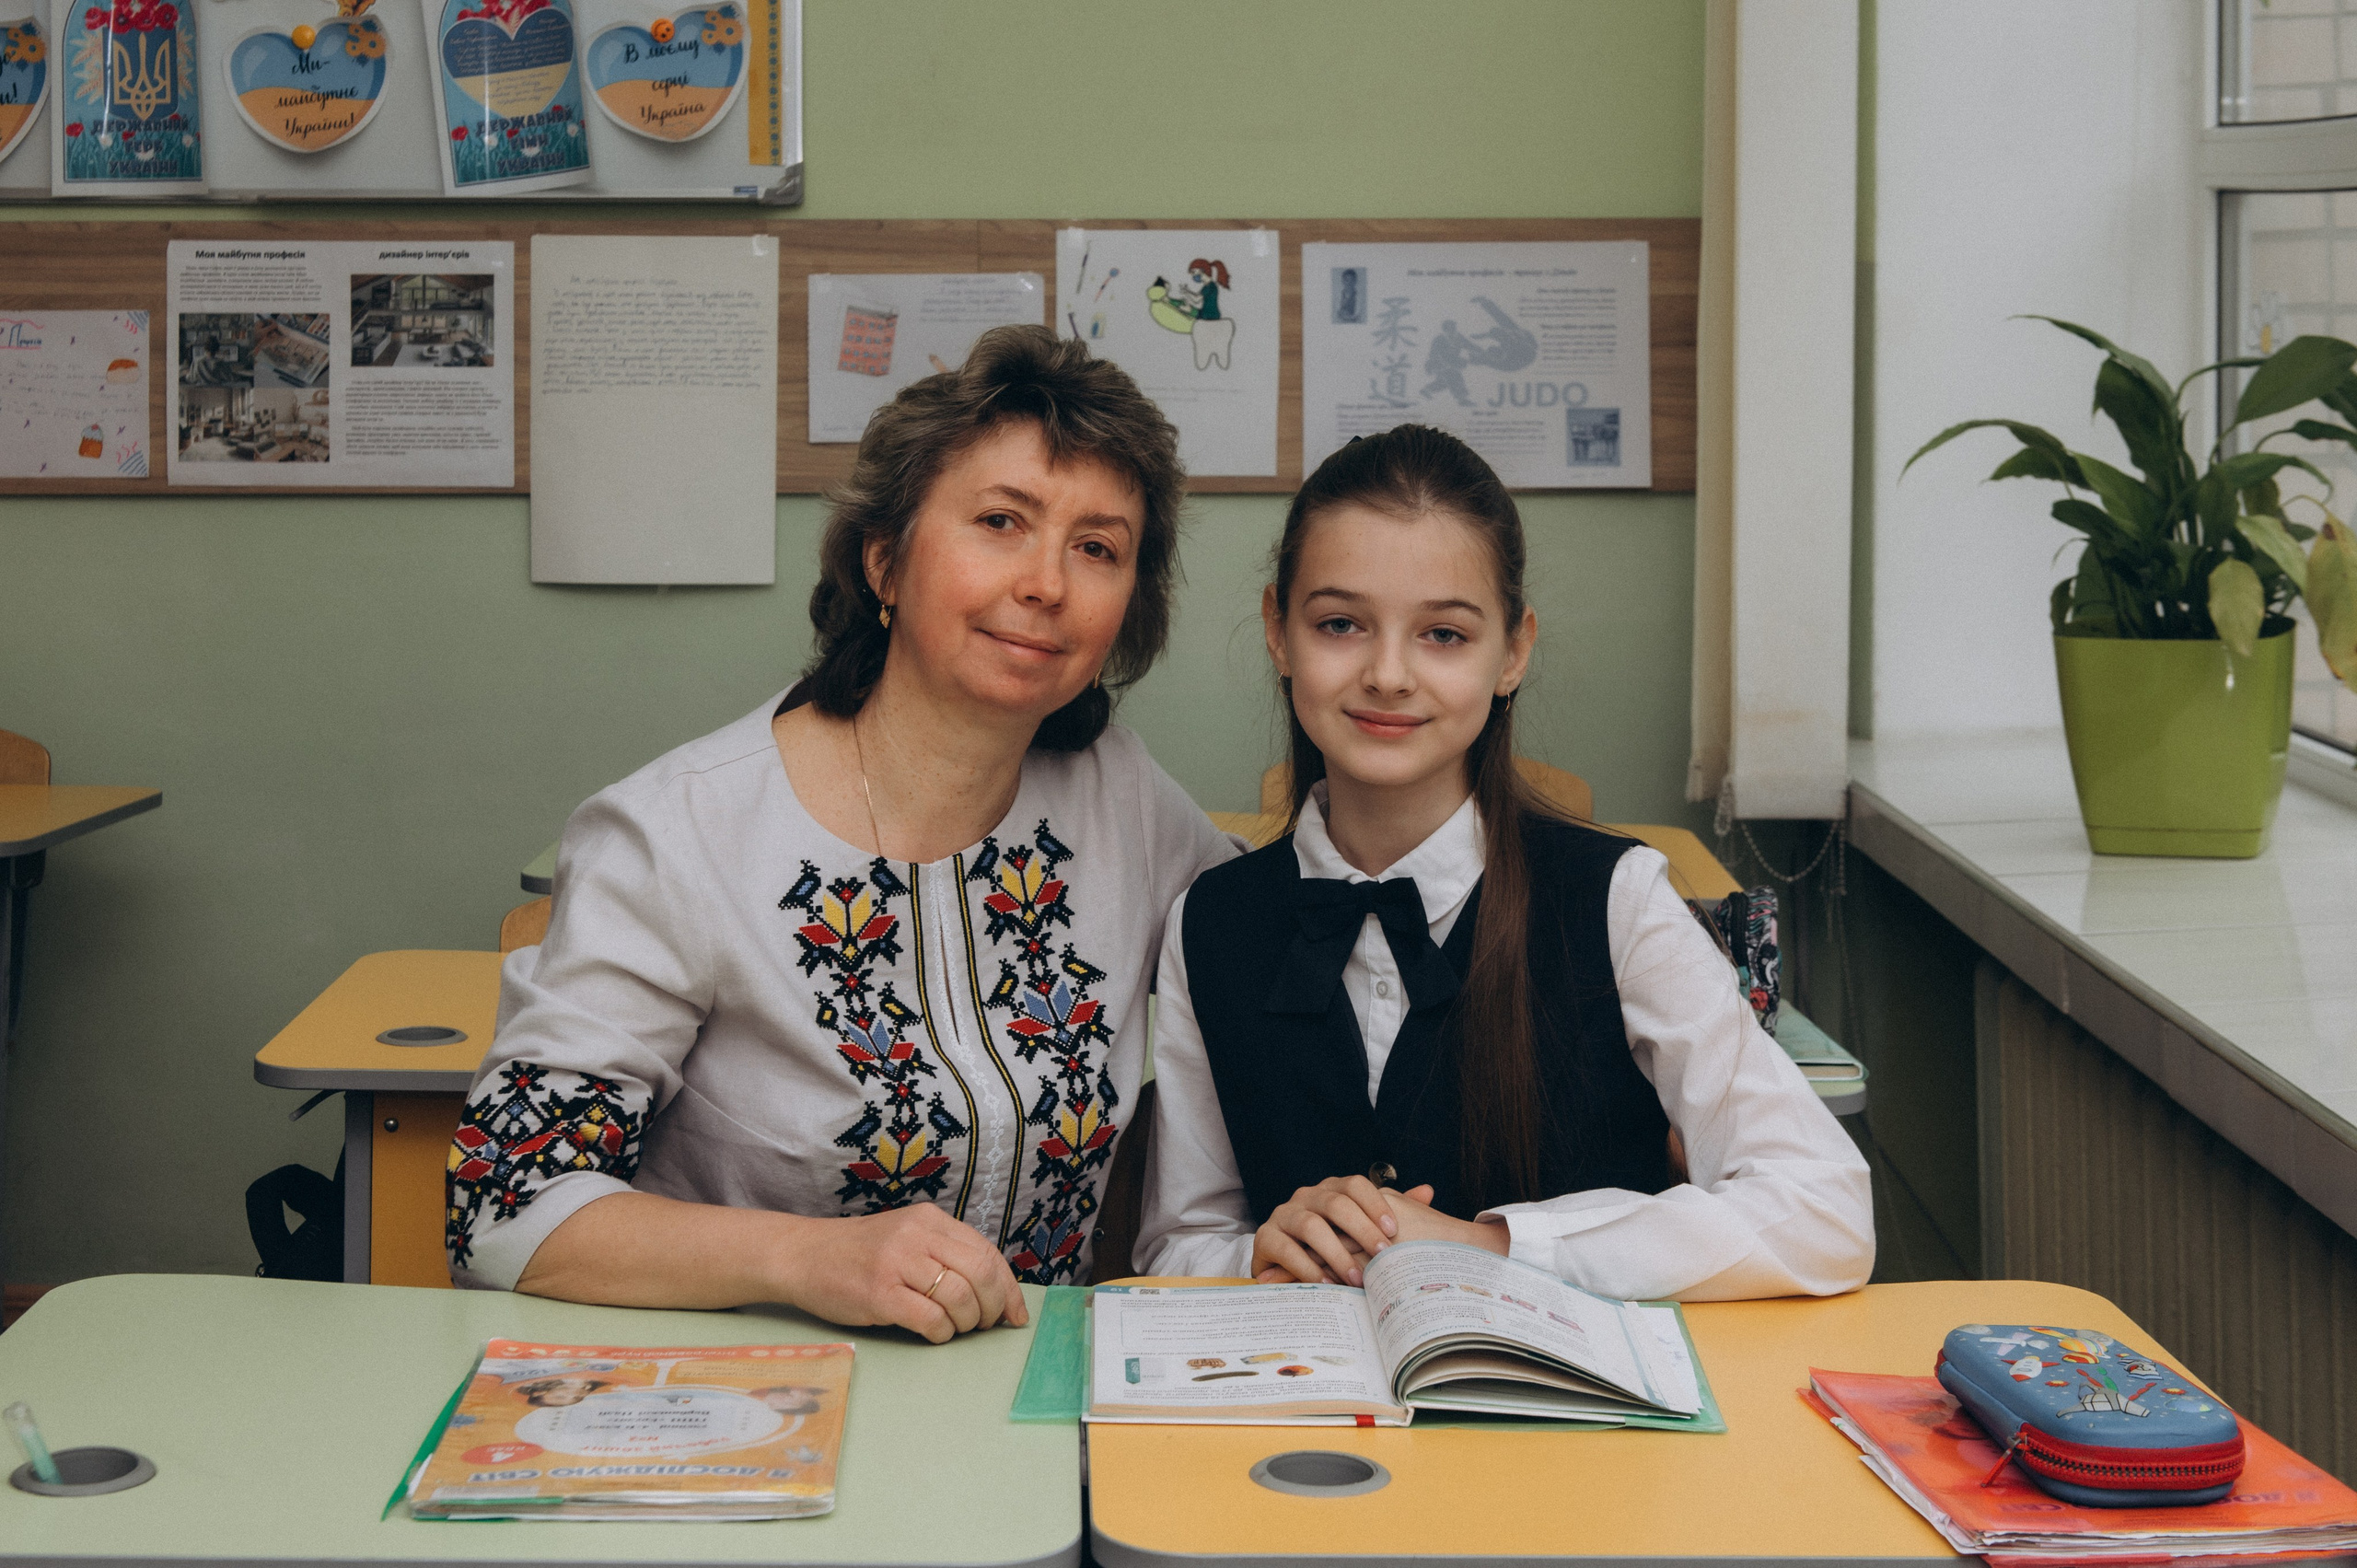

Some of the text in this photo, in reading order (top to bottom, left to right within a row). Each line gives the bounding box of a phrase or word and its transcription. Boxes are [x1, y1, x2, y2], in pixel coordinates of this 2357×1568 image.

[623, 40, 700, 64] В моєму
[651, 71, 690, 98] серці
[274, 85, 358, 110] майбутнє
[639, 103, 706, 126] Україна
[284, 112, 354, 139] України!
[125, 140, 163, 153] ГЕРБ
[109, 157, 178, 174] УКРАЇНИ
[195, 250, 307, 261] Моя майбутня професія
[378, 250, 424, 261] дизайнер
[1487, 381, 1588, 407] JUDO
[491, 1451, 516, 1464] 4
[467, 1469, 541, 1482] СВІТ
[548, 1465, 765, 1478] ДОСЛІДЖУЮ
